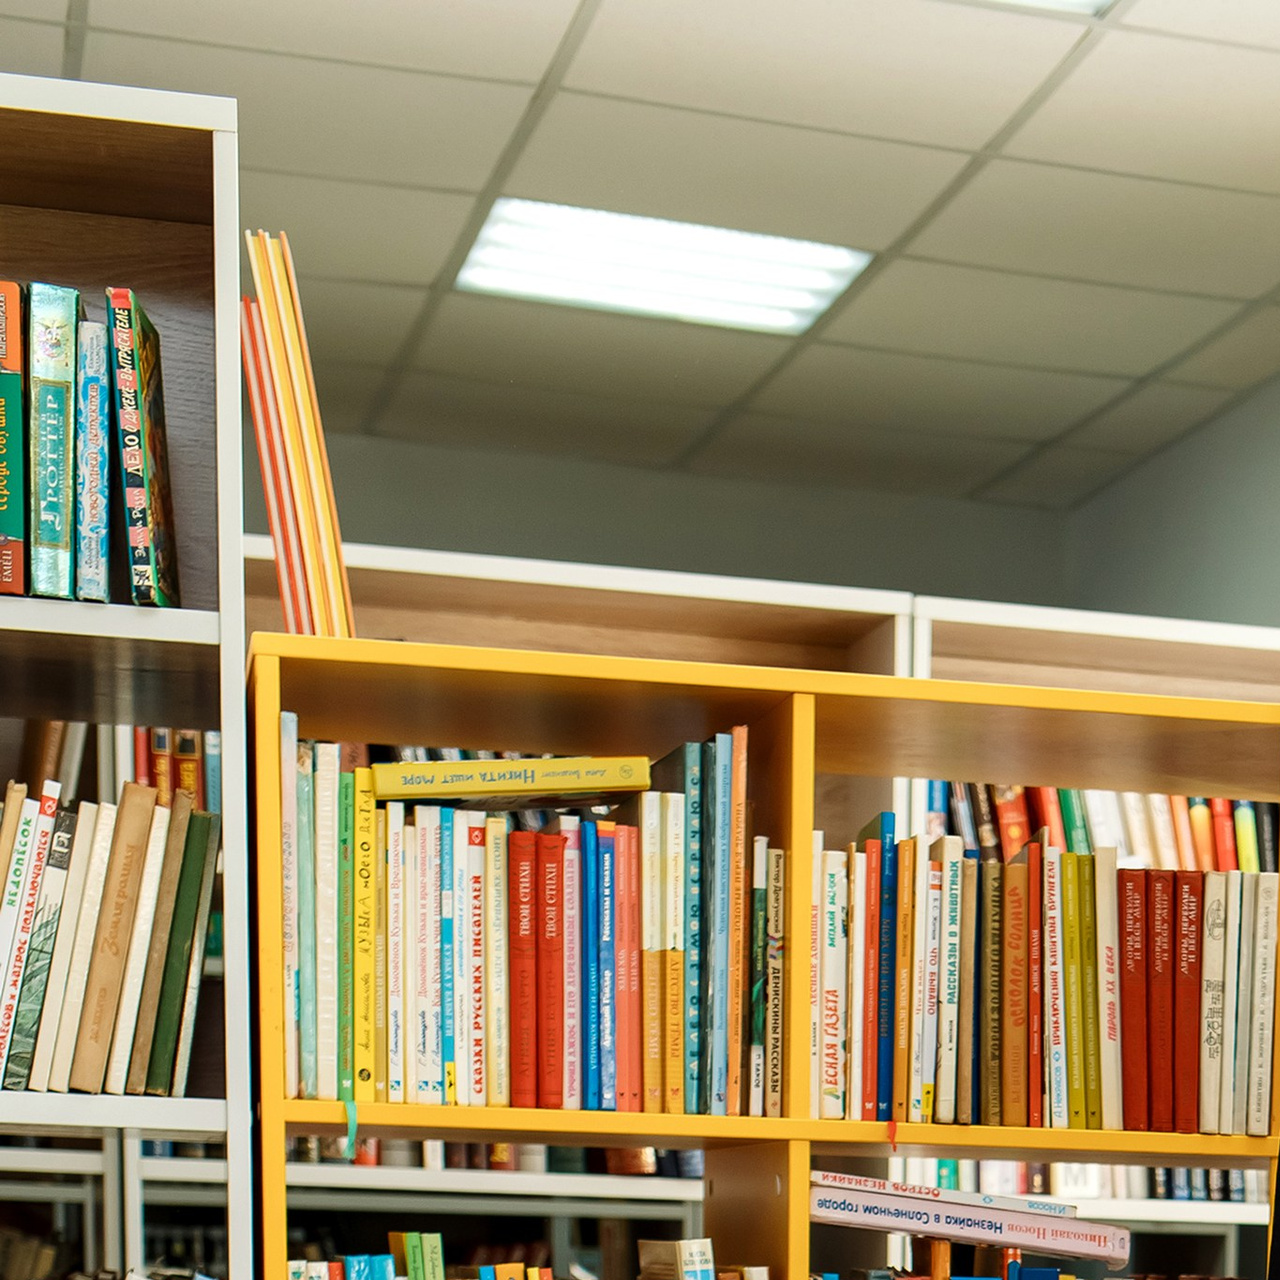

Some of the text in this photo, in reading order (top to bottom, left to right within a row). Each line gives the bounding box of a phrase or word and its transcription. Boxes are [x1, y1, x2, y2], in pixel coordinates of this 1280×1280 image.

[39, 411, 47, 478] ТАНЯ
[39, 394, 62, 531] ГРОТТЕР
[124, 435, 144, 477] ДЕЛО
[130, 489, 146, 519] Родда
[6, 816, 33, 907] НЕДОПЁСОК
[519, 861, 531, 903] СТИХИ
[544, 862, 557, 905] СТИХИ
[9, 829, 49, 990] МАТРОС ПОДКЛЮЧАЮТСЯ
[946, 859, 959, 1004] РАССКАЗЫ ЖИВОТНЫХ
[1007, 885, 1022, 950] СОЛНЦА
[1133, 891, 1141, 919] МИР
[1188, 894, 1198, 920] МИР
[469, 874, 483, 1095] СКАЗКИ РУССКИХ ПИСАТЕЛЕЙ
[926, 947, 937, 1016] ЧТО БЫВАЛО
[1046, 860, 1062, 1046] ПРИКЛЮЧЕНИЯ КАПИТАНА ВРУНГЕЛЯ
[1104, 945, 1115, 975] ВЕКА
[770, 966, 782, 1094] ДЕНИСКИНЫ РАССКАЗЫ
[821, 1173, 941, 1199] ОСТРОВ НЕЗНАЙКИ
[816, 1197, 1108, 1248] Николай Носов Незнайка Солнечном городе
